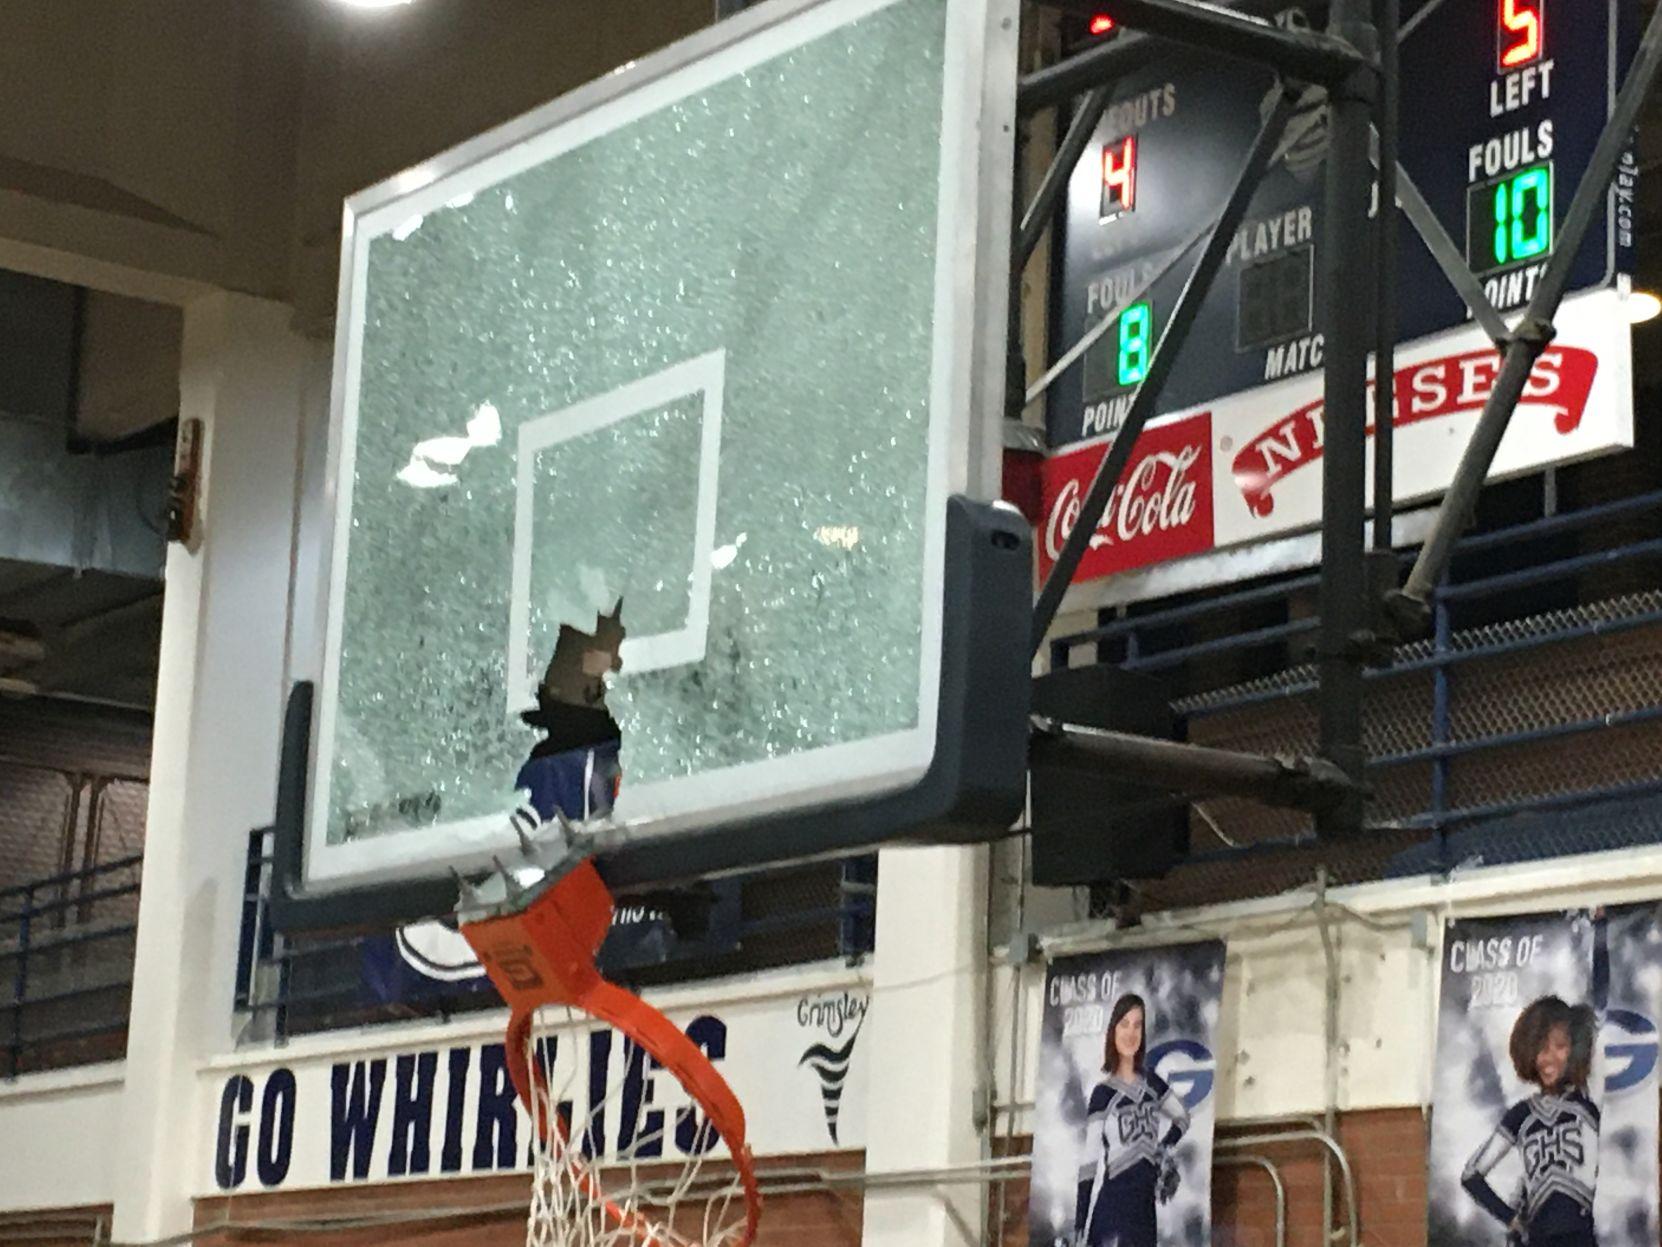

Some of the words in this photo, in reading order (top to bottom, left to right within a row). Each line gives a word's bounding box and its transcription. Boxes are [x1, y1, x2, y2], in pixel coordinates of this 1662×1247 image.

[1502, 0, 1540, 66] 5
[1114, 82, 1176, 131] OUTS
[1490, 58, 1554, 118] LEFT
[1102, 134, 1137, 211] 4
[1468, 118, 1553, 182] FOULS
[1494, 166, 1549, 264] 10
[1468, 261, 1548, 315] OINT
[1118, 303, 1150, 386] 8
[1264, 333, 1324, 380] MATC
[1082, 394, 1134, 437] POIN
[1045, 444, 1202, 561] Coa-Cola
[1451, 935, 1513, 973] CLASS
[1516, 934, 1544, 967] OF
[1050, 971, 1097, 1007] CLASS
[1101, 969, 1123, 1002] OF
[1471, 971, 1518, 1007] 2020
[215, 1067, 296, 1190] GO
[1522, 1127, 1584, 1181] GHS
